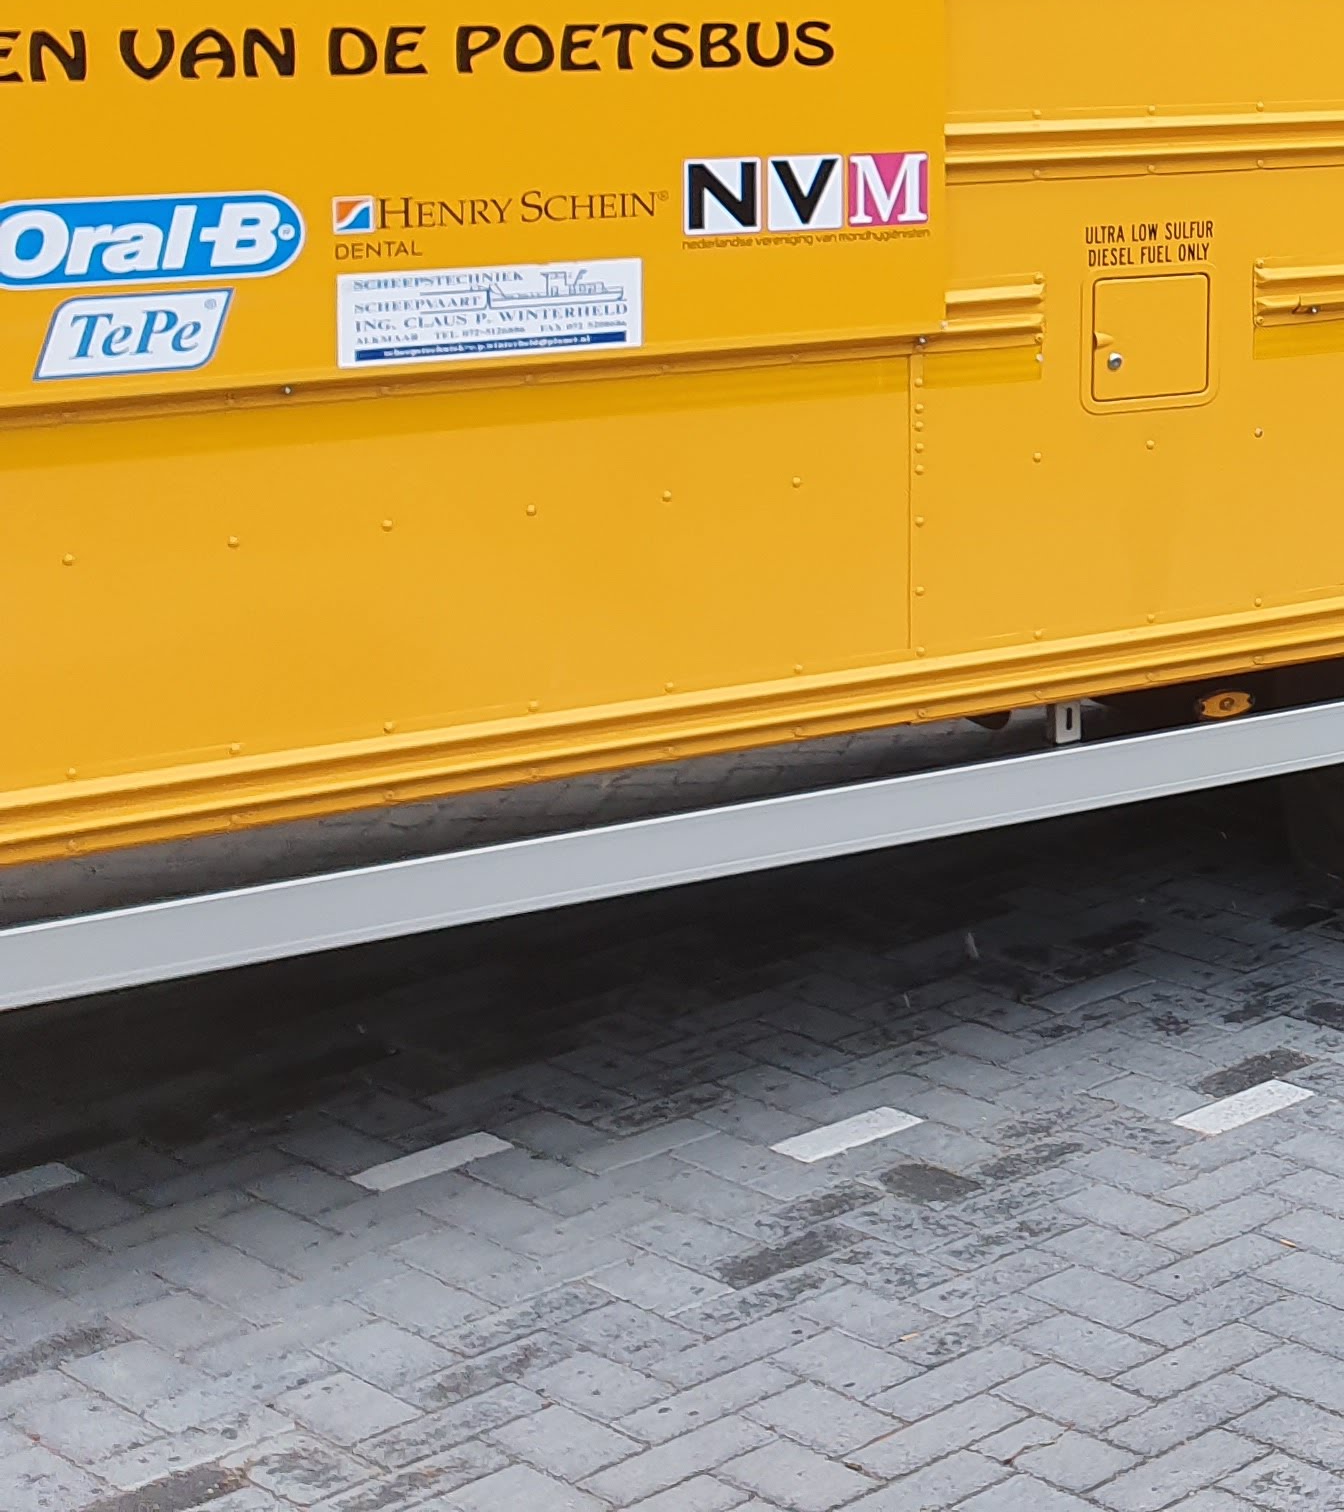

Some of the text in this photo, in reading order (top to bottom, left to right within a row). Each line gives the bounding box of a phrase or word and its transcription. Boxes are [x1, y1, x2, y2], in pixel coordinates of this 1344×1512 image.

[119, 28, 295, 80] VAN
[328, 25, 428, 76] DE
[456, 20, 835, 74] POETSBUS
[688, 152, 927, 230] NVM
[0, 201, 281, 280] Oral-B
[1085, 220, 1214, 244] ULTRA LOW SULFUR
[335, 240, 423, 260] DENTAL
[1088, 243, 1210, 267] DIESEL FUEL ONLY
[354, 295, 480, 314] SCHEEPVAART
[403, 313, 467, 329] CLAUS
[500, 303, 627, 322] WINTERHELD
[69, 308, 203, 362] TePe
